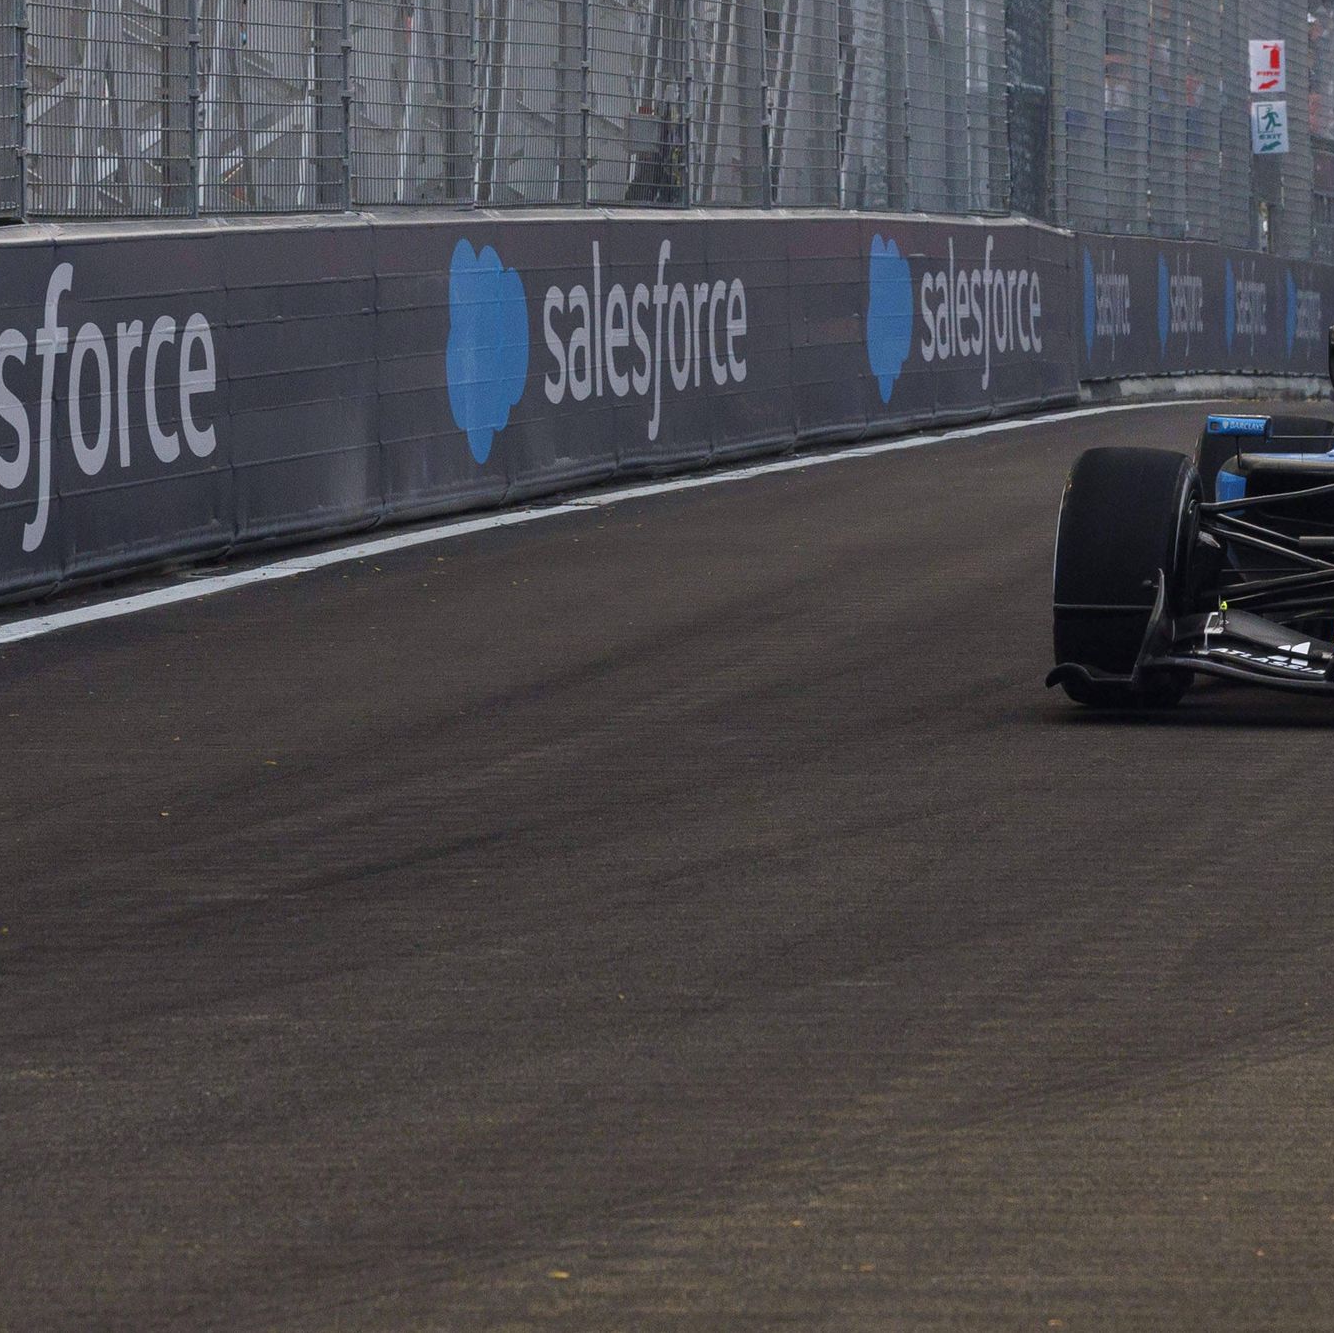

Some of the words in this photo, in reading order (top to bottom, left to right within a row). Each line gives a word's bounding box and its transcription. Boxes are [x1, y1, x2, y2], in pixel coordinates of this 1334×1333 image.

[544, 239, 747, 441] salesforce
[921, 234, 1043, 390] salesforce
[1229, 421, 1264, 430] BARCLAYS
